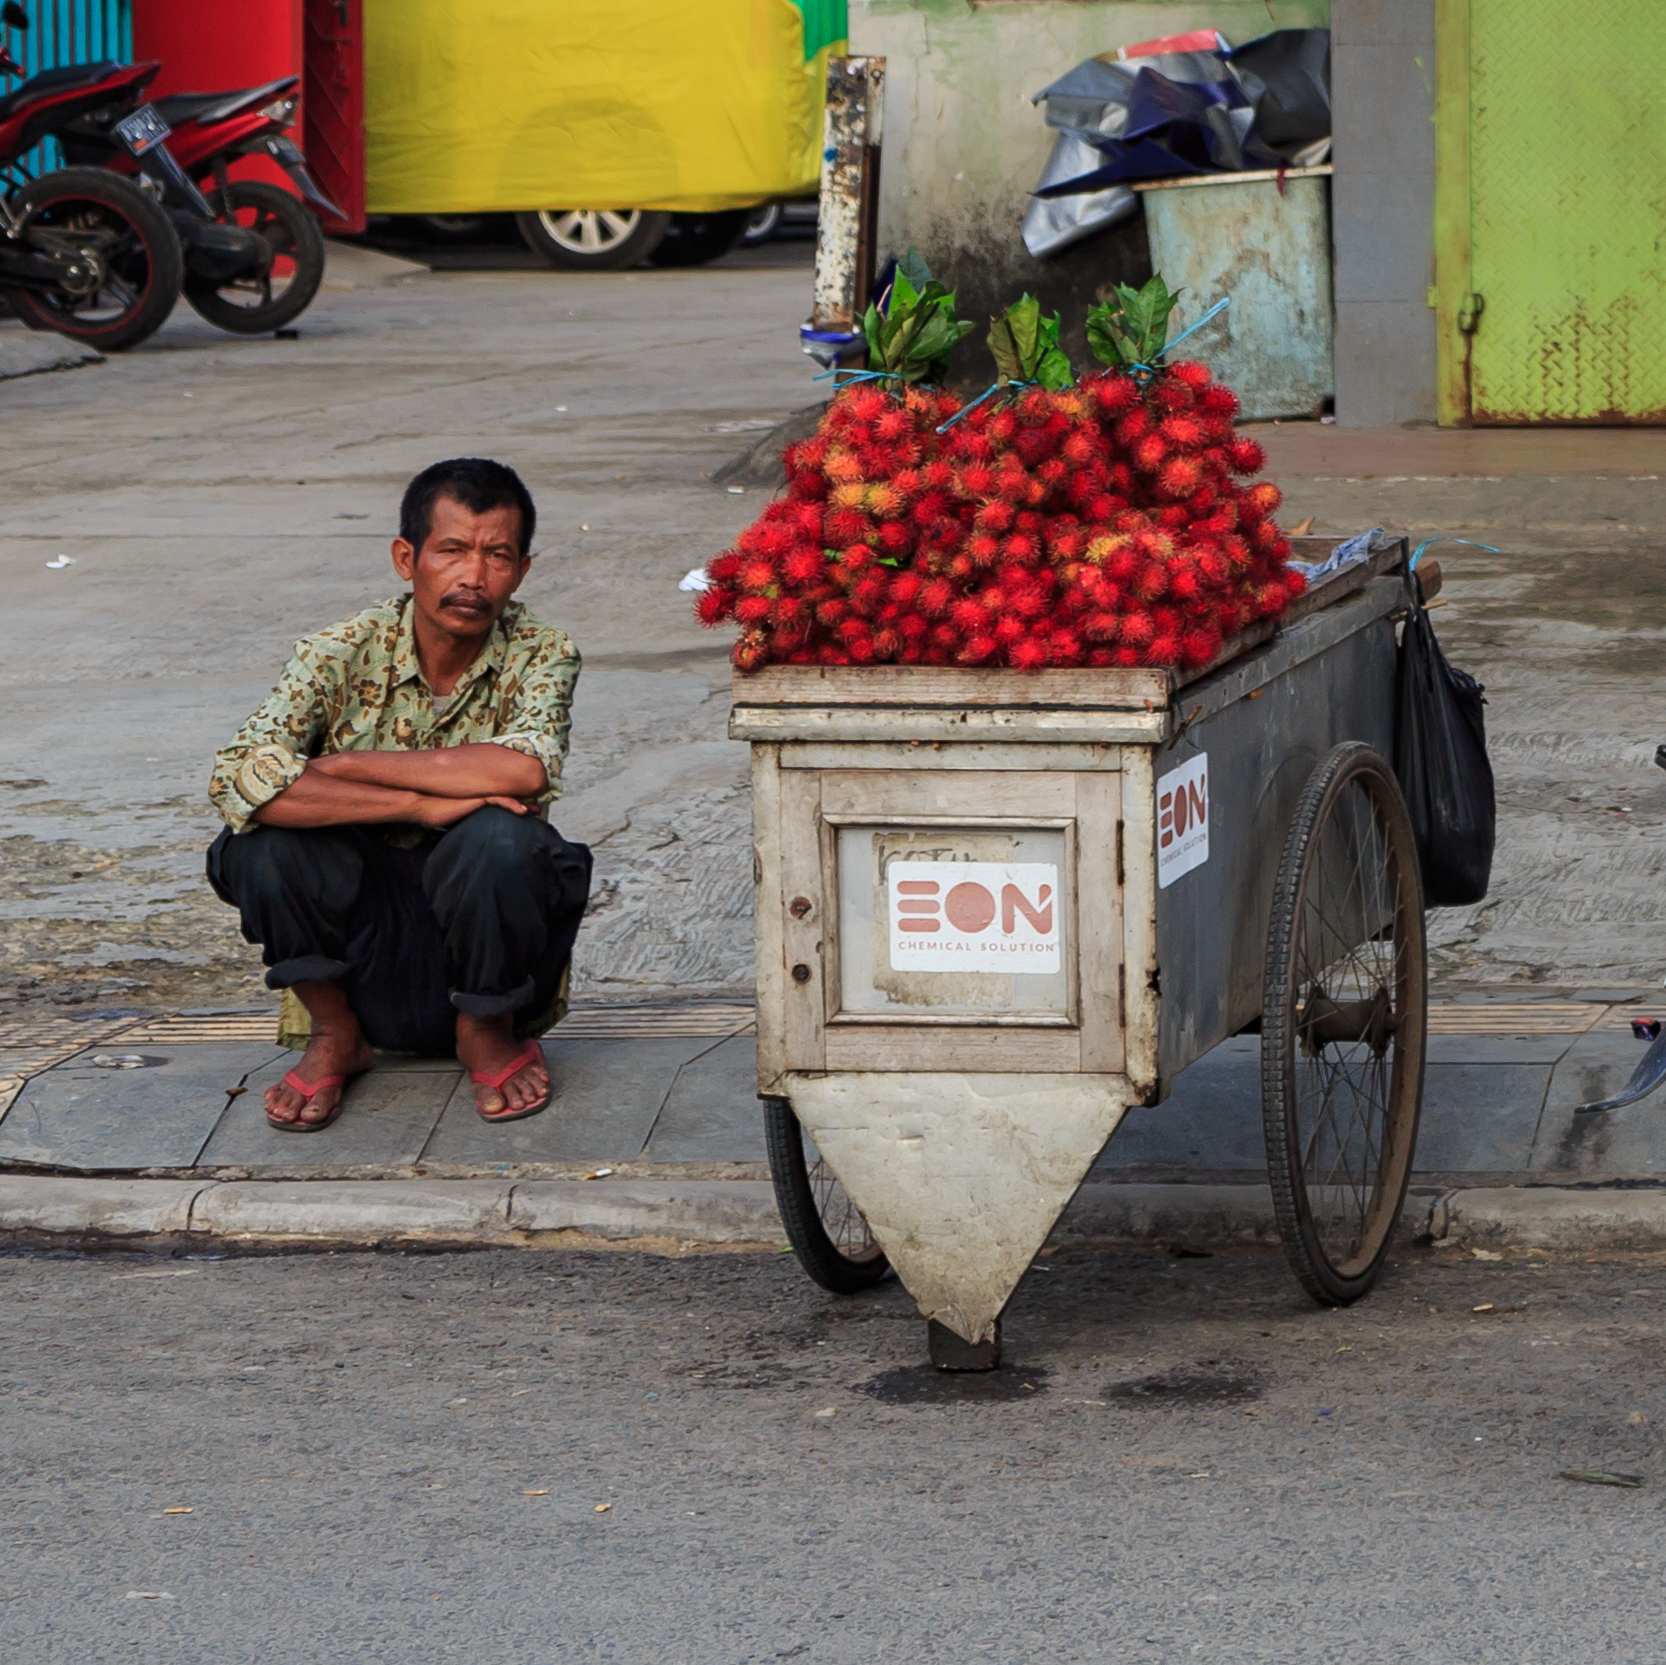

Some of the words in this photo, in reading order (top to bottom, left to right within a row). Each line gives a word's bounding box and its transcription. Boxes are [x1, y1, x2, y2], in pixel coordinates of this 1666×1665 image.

[1160, 774, 1206, 849] EON
[897, 880, 1052, 935] EON
[898, 941, 972, 951] CHEMICAL
[980, 942, 1055, 952] SOLUTION
